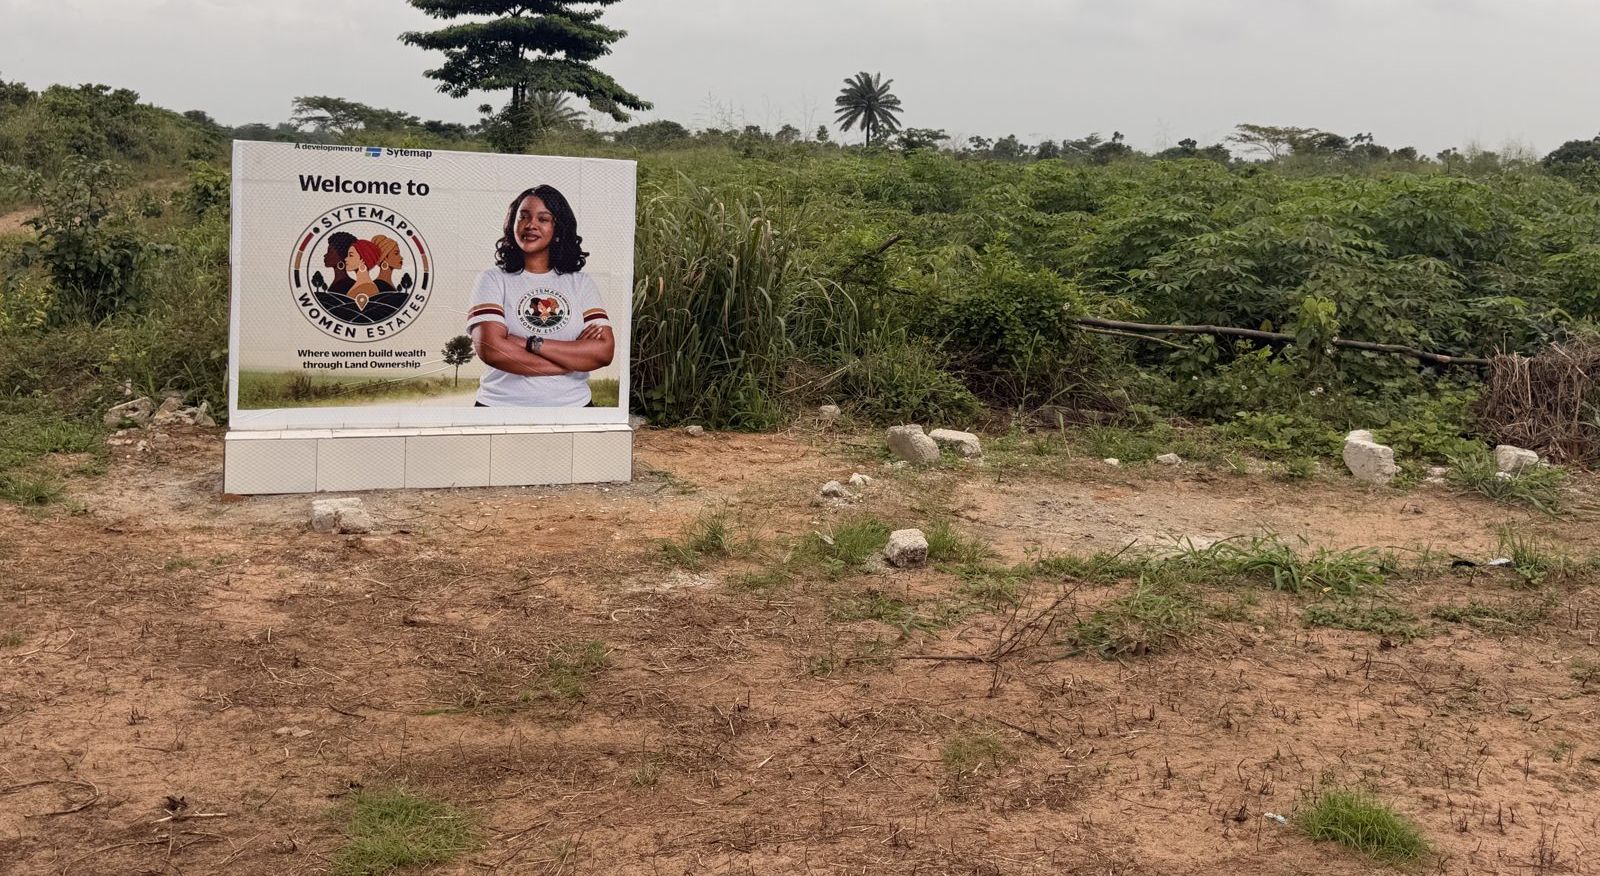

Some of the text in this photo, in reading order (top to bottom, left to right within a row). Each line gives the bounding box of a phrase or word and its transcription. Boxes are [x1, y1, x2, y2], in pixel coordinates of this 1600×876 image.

[294, 142, 301, 150] A
[302, 143, 353, 152] development
[386, 148, 433, 159] Sytemap
[299, 175, 430, 196] Welcome to
[321, 207, 408, 231] SYTEMAP
[299, 293, 425, 338] WOMEN ESTATES
[297, 349, 427, 358] Where women build wealth
[303, 360, 421, 370] through Land Ownership
